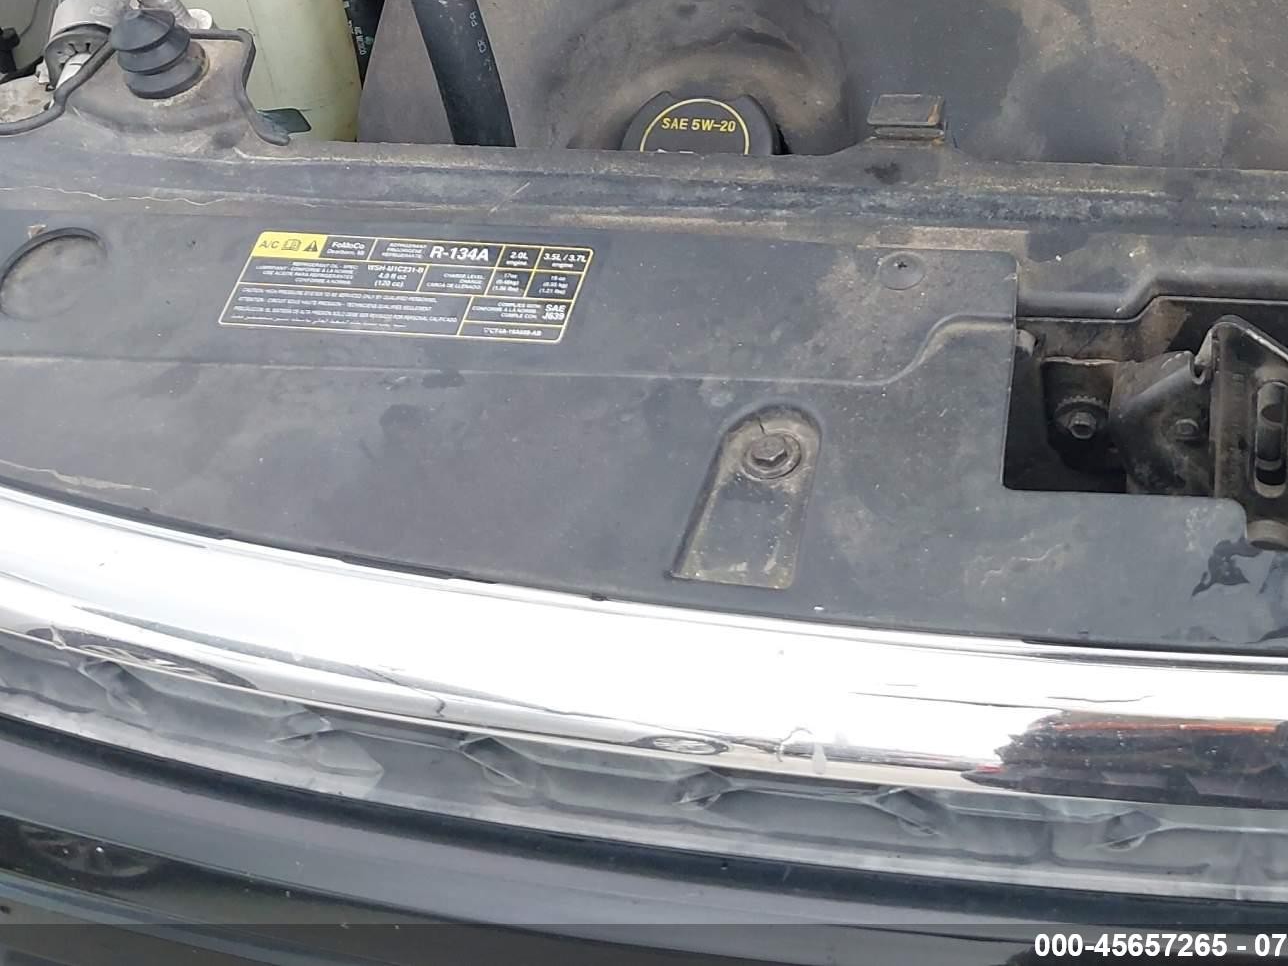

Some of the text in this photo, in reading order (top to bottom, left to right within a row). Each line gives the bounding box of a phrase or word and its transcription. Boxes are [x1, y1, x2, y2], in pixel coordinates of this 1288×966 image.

[661, 117, 737, 133] SAE 5W-20
[259, 240, 280, 249] A/C
[429, 245, 489, 262] R-134A
[509, 251, 528, 260] 2.0L
[543, 253, 561, 261] 3.5L
[568, 254, 587, 263] 3.7L
[545, 304, 566, 313] SAE
[541, 312, 565, 321] J639
